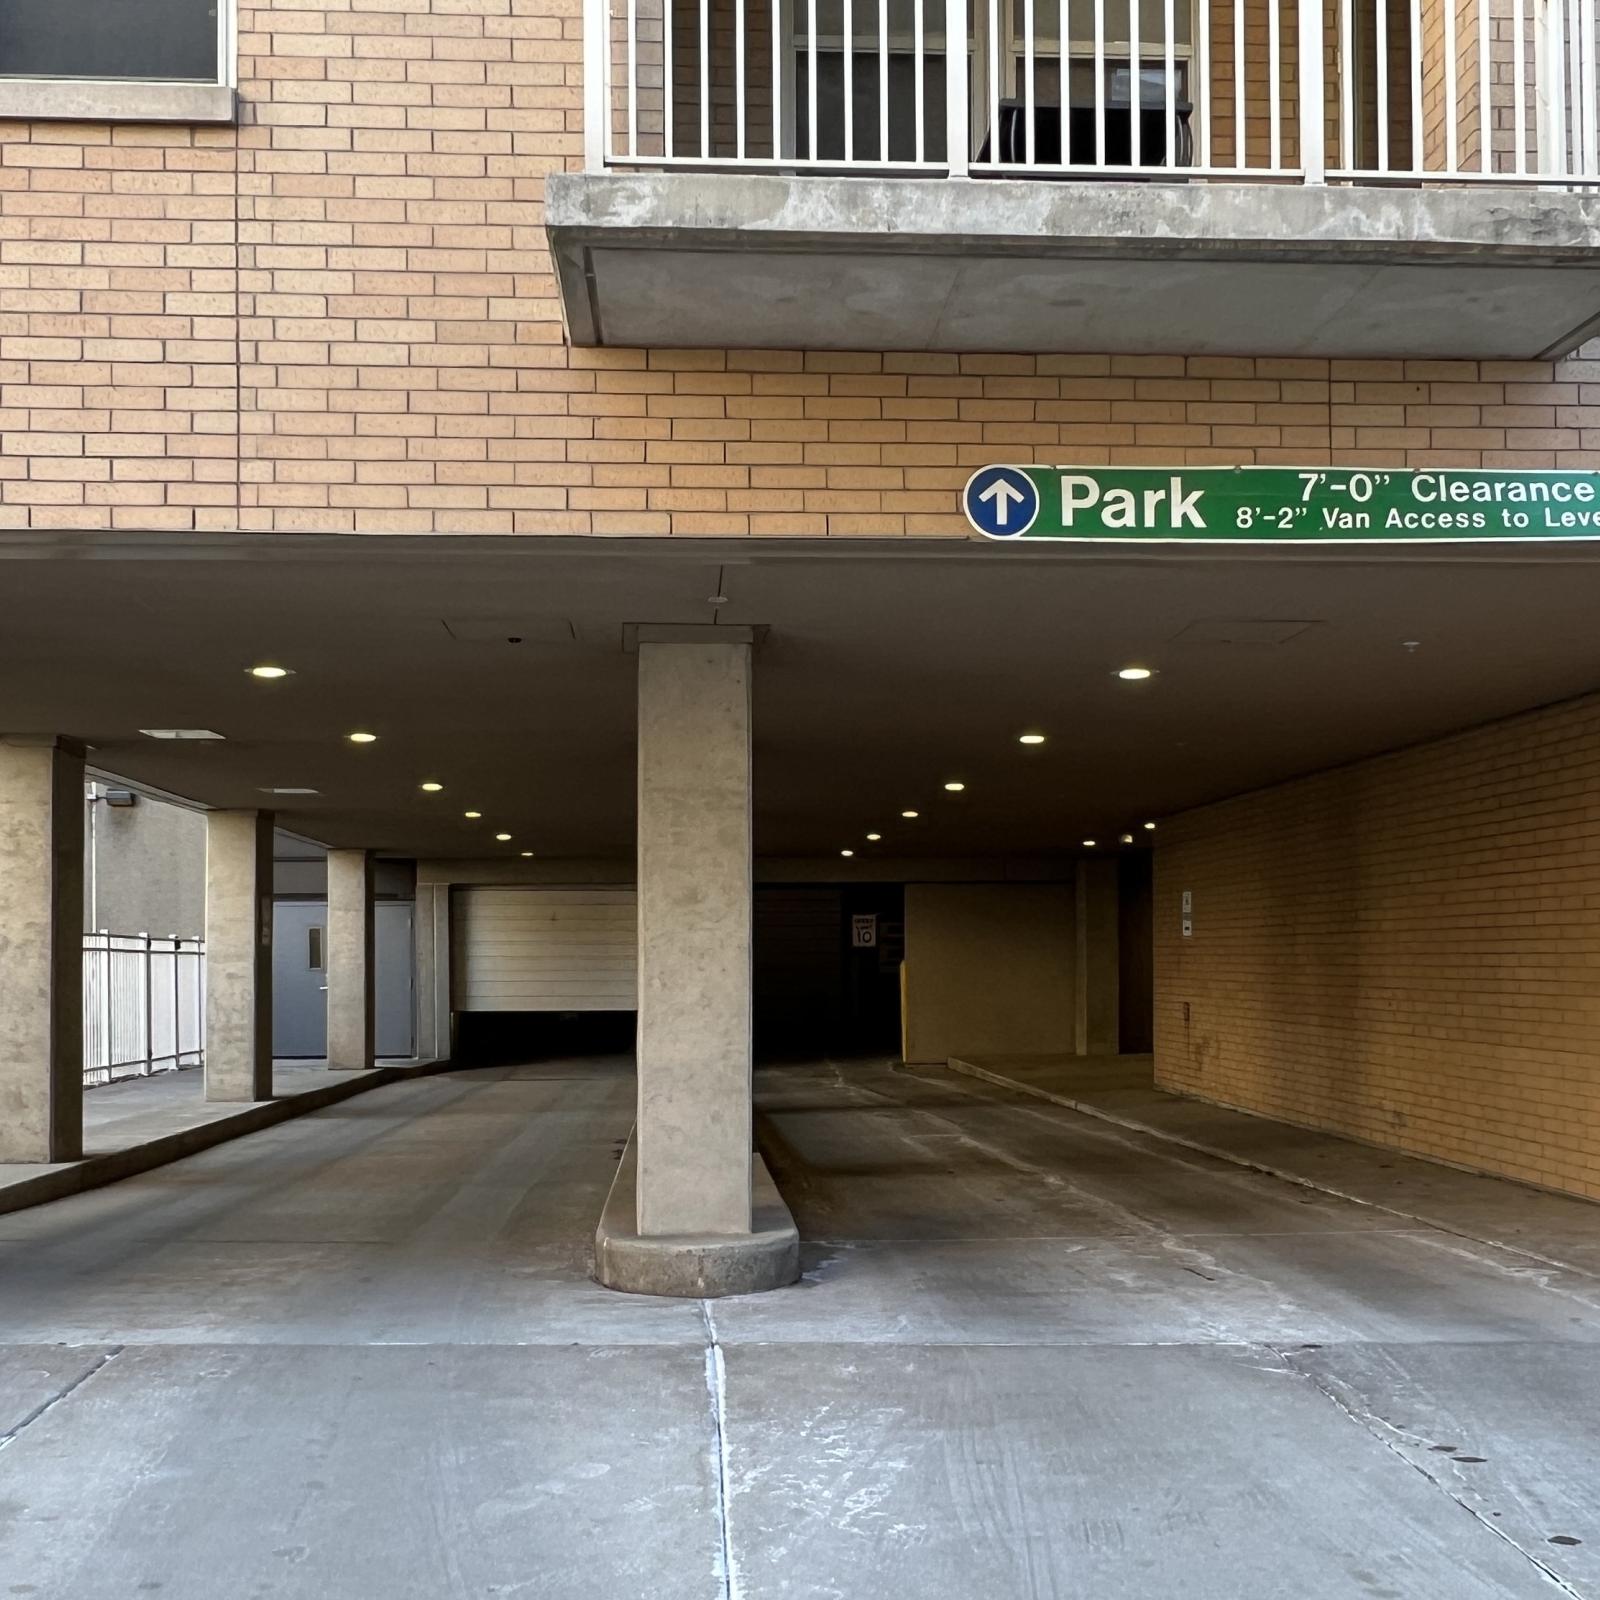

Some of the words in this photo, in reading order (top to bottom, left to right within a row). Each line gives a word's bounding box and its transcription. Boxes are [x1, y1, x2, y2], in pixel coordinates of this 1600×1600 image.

[1411, 474, 1595, 503] Clearance
[1060, 475, 1207, 528] Park
[1322, 507, 1370, 529] Van
[1385, 507, 1486, 529] Access
[1501, 508, 1529, 528] to
[857, 931, 872, 943] 10
